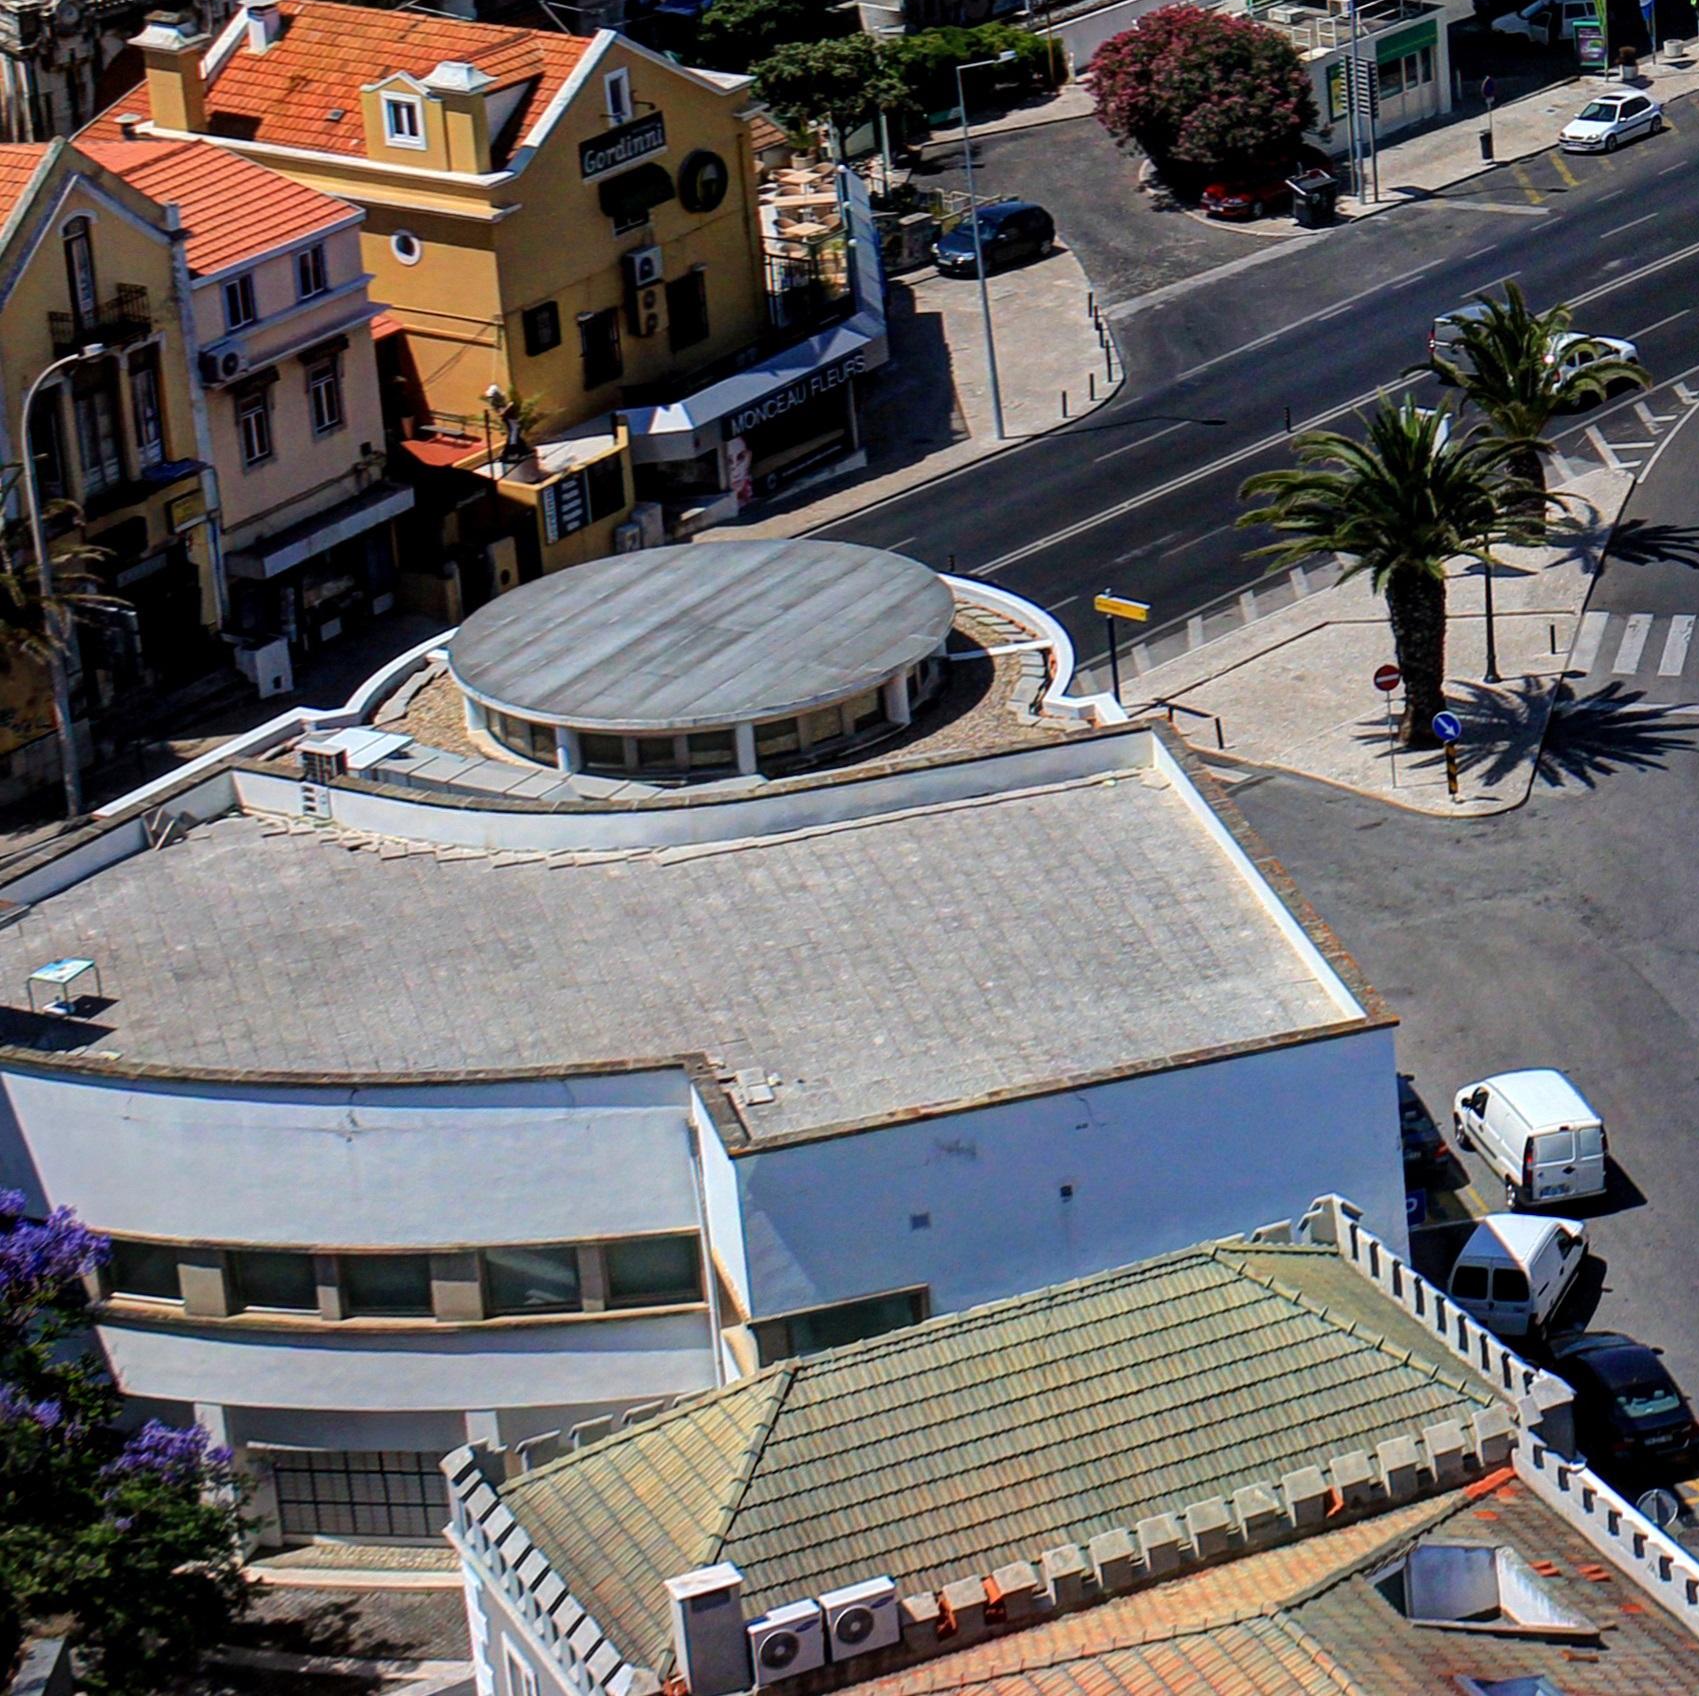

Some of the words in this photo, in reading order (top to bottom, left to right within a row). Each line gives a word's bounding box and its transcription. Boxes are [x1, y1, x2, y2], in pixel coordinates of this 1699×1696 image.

[583, 122, 664, 174] Gordinni
[731, 383, 807, 437] MONCEAU
[810, 354, 867, 397] FLEURS
